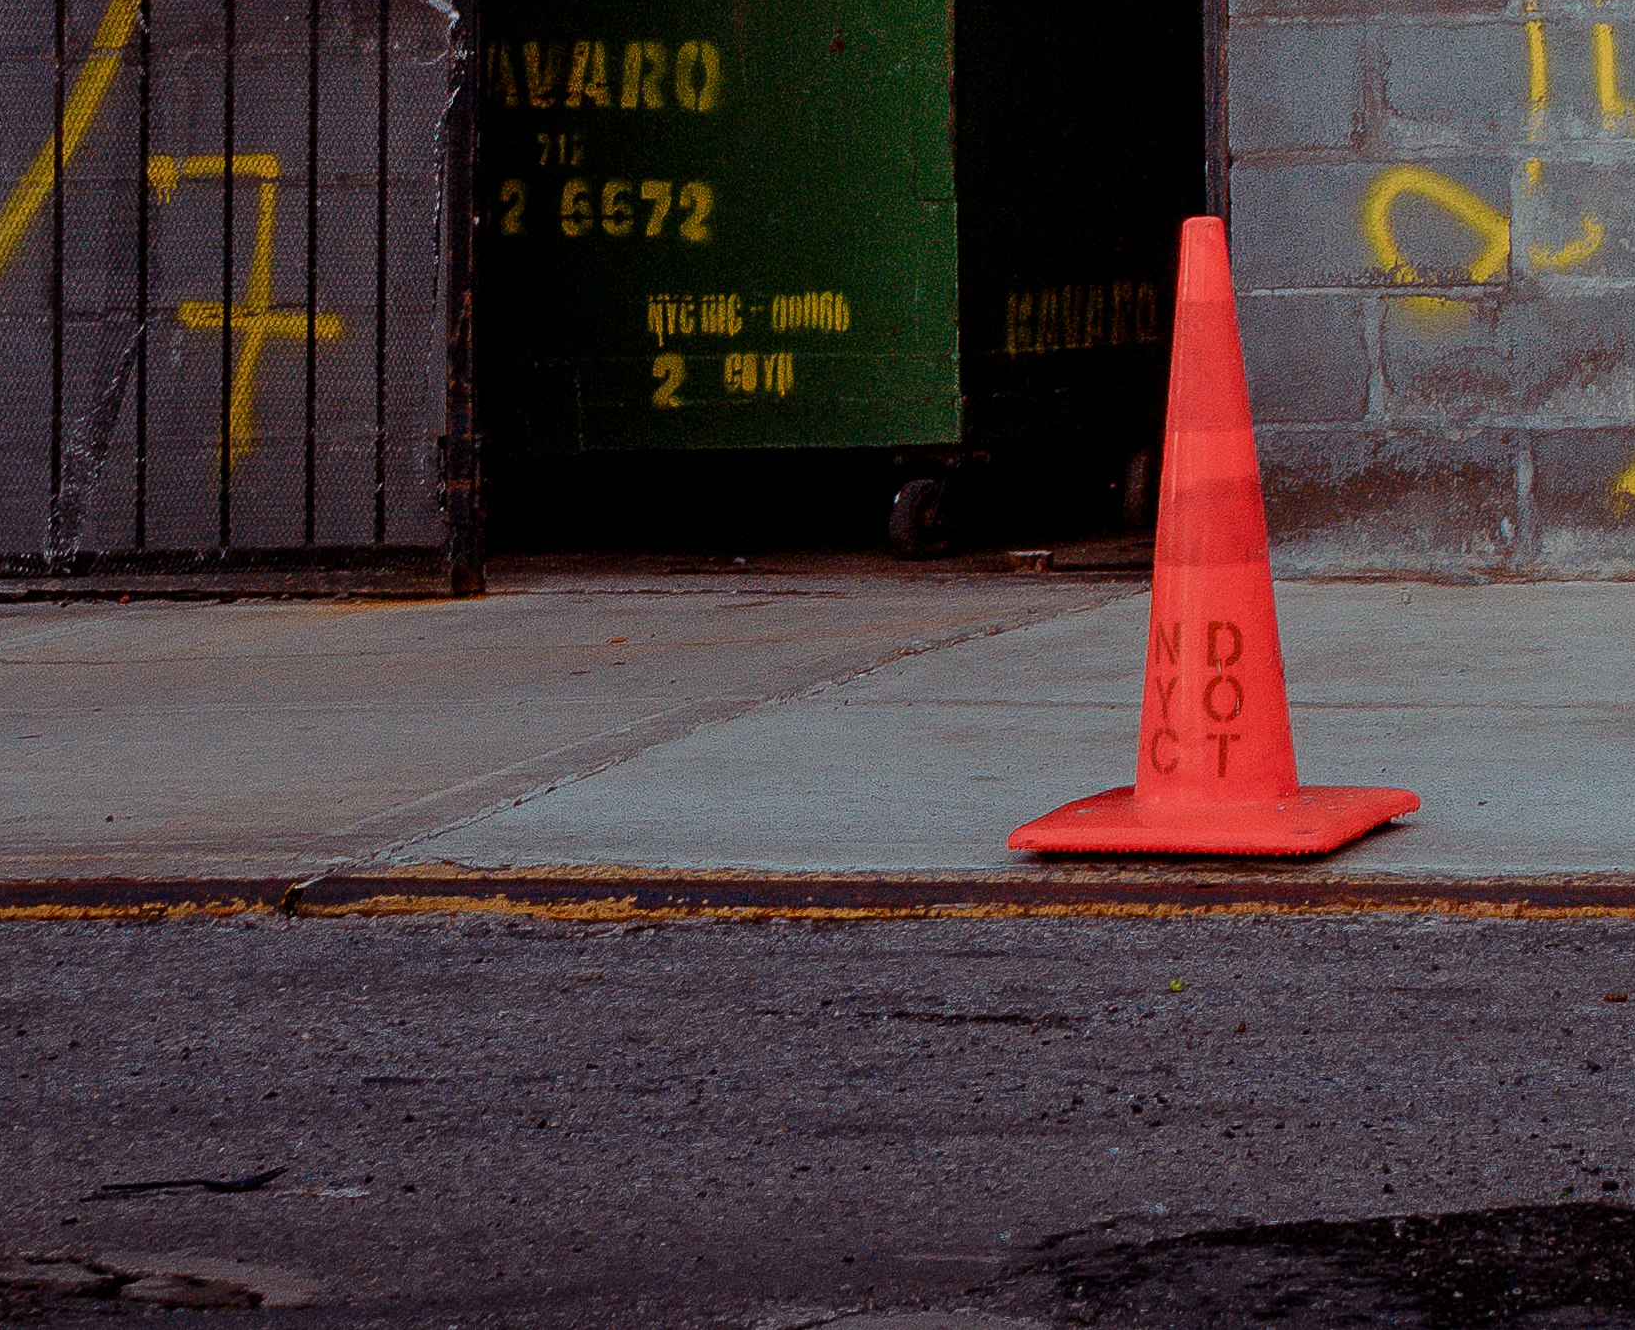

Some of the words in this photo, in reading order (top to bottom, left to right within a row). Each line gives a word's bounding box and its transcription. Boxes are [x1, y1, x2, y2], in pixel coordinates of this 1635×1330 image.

[651, 351, 688, 409] 2
[1147, 619, 1181, 777] NYC
[1203, 618, 1246, 779] DOT
